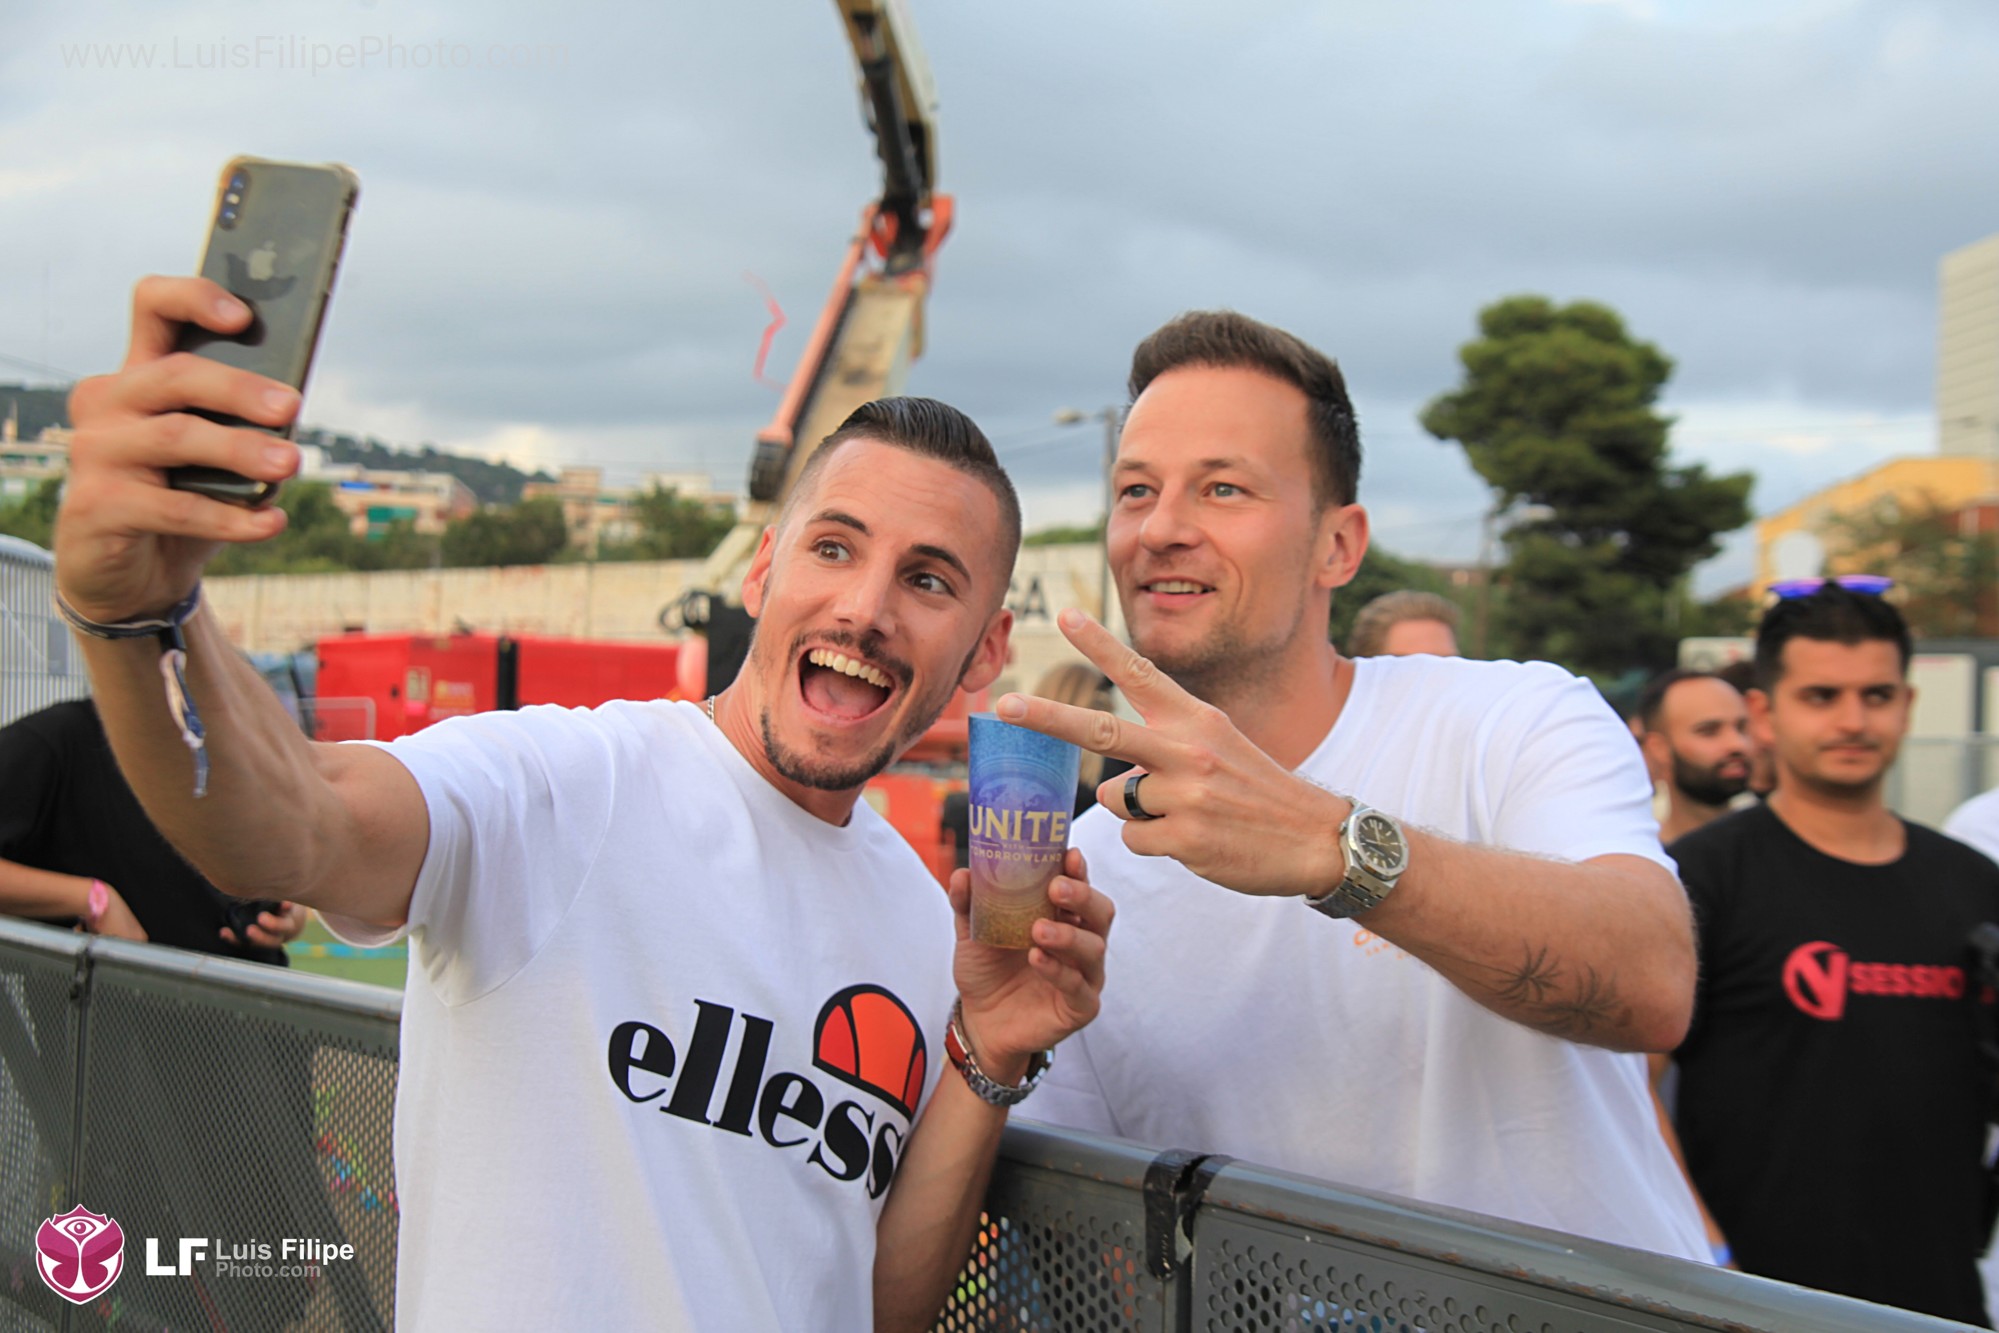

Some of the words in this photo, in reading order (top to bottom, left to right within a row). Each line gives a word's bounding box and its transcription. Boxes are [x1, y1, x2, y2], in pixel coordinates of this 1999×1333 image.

[969, 804, 1067, 842] UNITE
[1851, 961, 1965, 999] SESSIO
[608, 998, 904, 1200] elless
